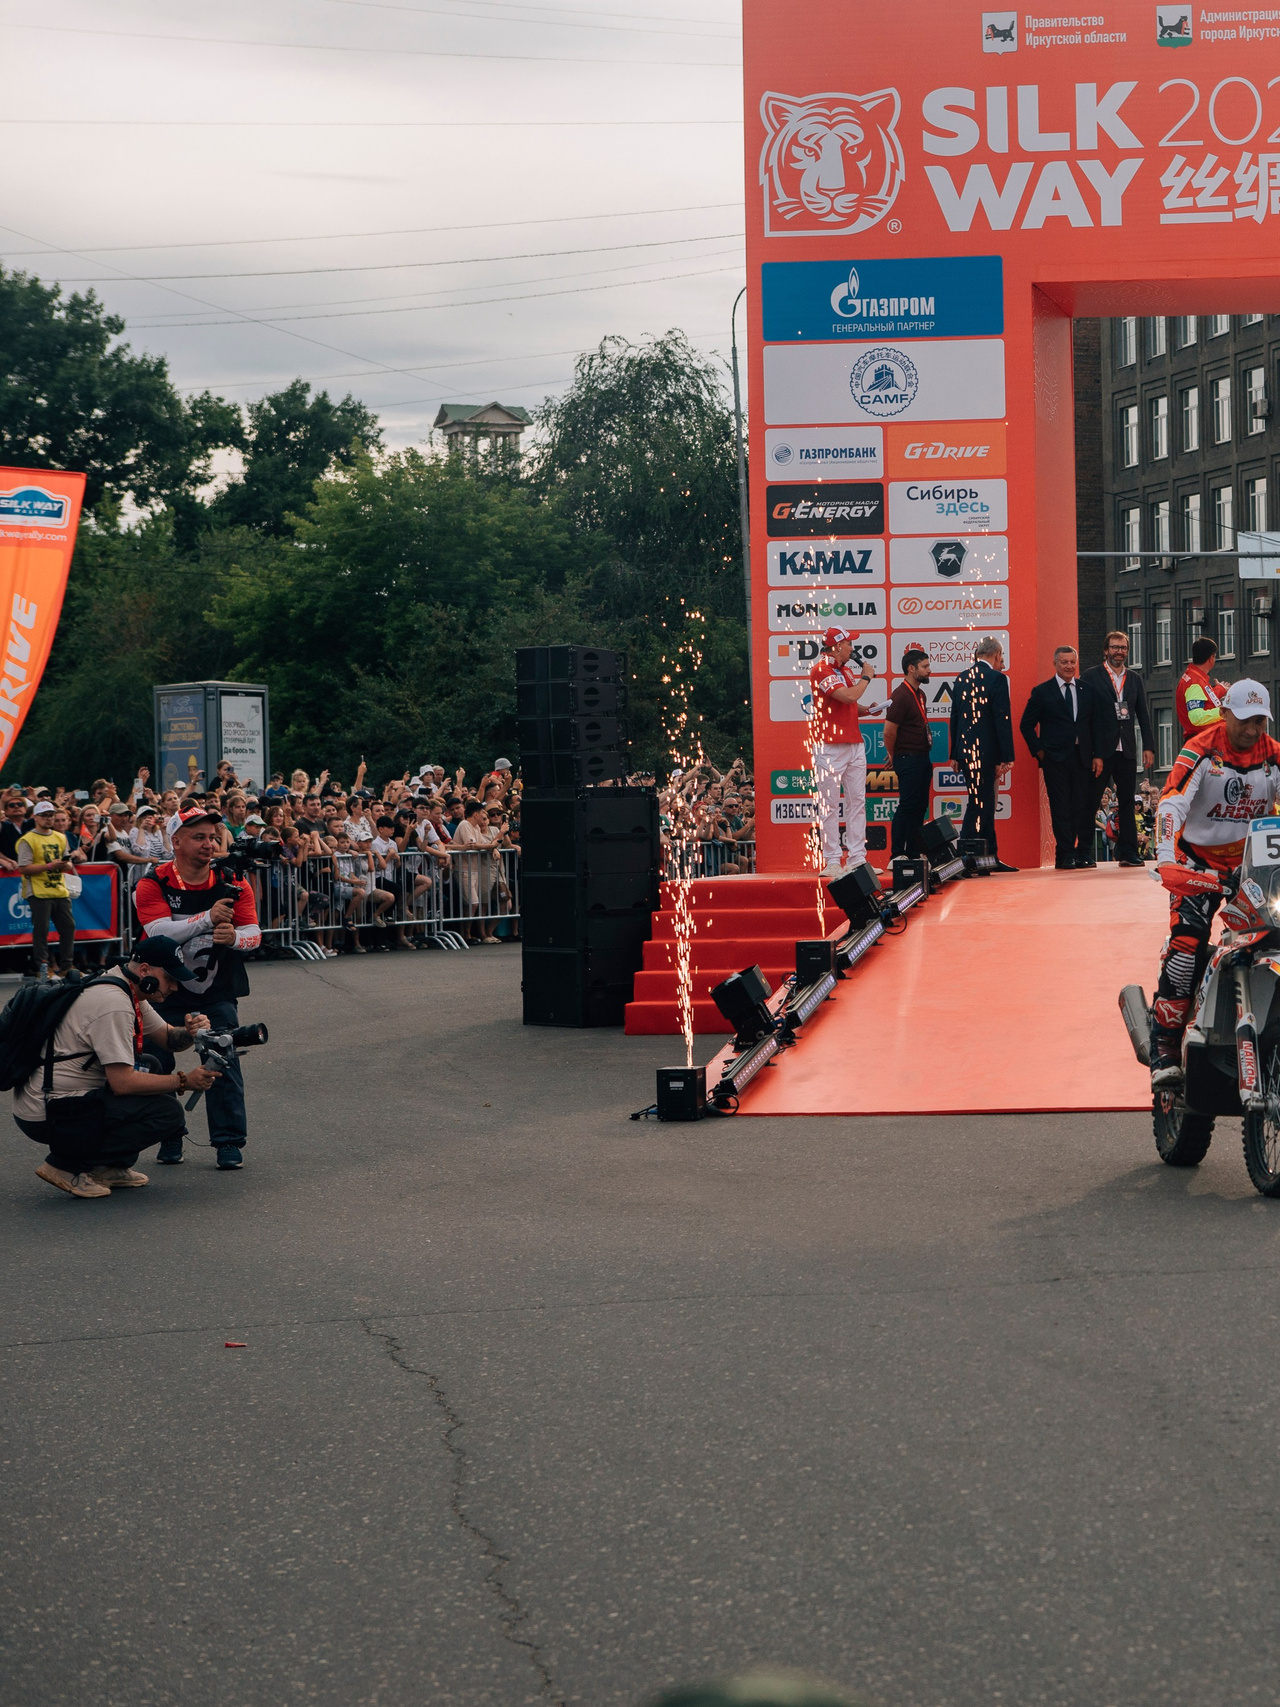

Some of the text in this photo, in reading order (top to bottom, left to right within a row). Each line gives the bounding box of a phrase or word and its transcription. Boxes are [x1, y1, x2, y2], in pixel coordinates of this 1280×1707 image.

[1025, 15, 1104, 31] Правительство
[1025, 30, 1127, 49] Иркутской области
[1200, 27, 1236, 42] города
[922, 81, 1144, 156] SILK
[924, 158, 1145, 232] WAY
[862, 296, 935, 317] ГАЗПРОМ
[832, 321, 935, 333] ГЕНЕРАЛЬНЫЙ ПАРТНЕР
[860, 394, 909, 405] CAMF
[800, 447, 877, 460] ГАЗПРОМБАНК
[906, 485, 979, 503] Сибирь
[33, 501, 62, 511] WAY
[936, 501, 990, 516] здесь
[0, 529, 67, 542] kwayrally.com
[779, 550, 873, 575] KAMAZ
[777, 602, 877, 617] MONGOLIA
[925, 598, 1003, 611] СОГЛАСИЕ
[797, 640, 878, 660] Dko
[930, 641, 978, 651] РУССКА
[930, 652, 977, 663] МЕХАН
[1186, 879, 1220, 891] ACERBIS
[1242, 1040, 1256, 1086] NAIKOM
